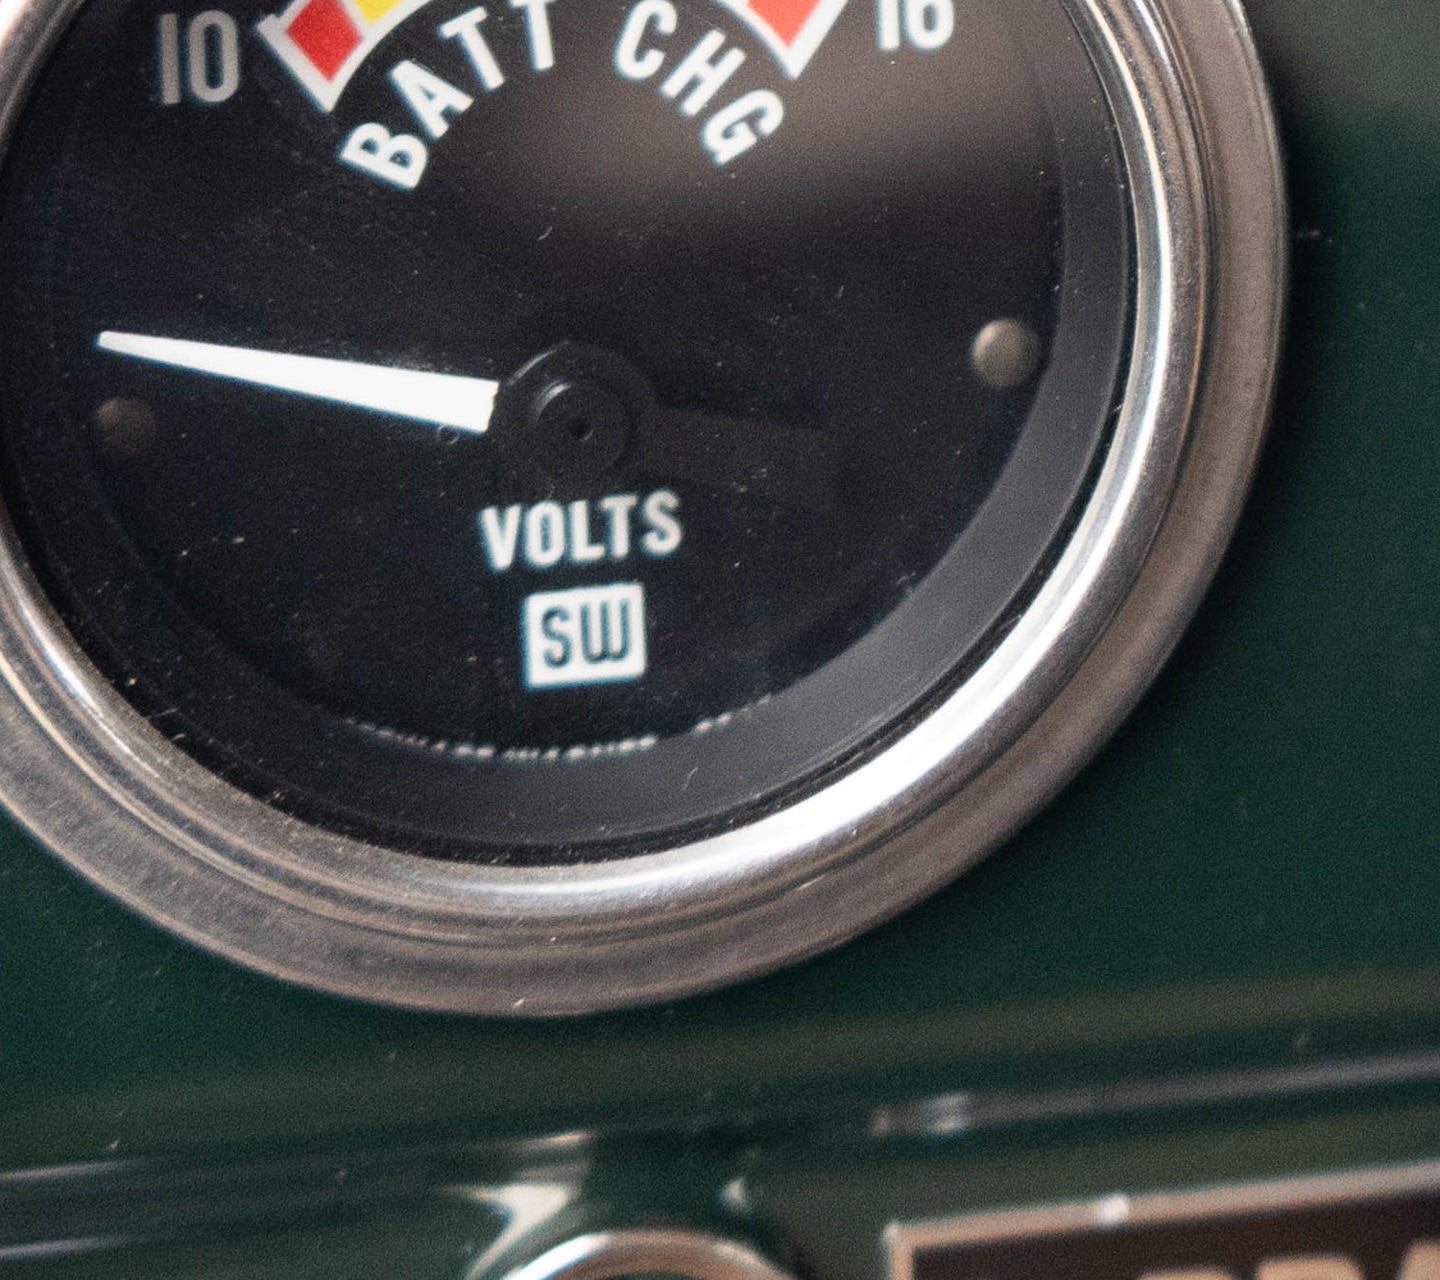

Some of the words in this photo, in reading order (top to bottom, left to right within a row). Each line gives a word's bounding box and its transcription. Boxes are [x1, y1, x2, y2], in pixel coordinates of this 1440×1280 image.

[159, 9, 240, 106] 10
[478, 488, 683, 571] VOLTS
[537, 593, 635, 672] SW
